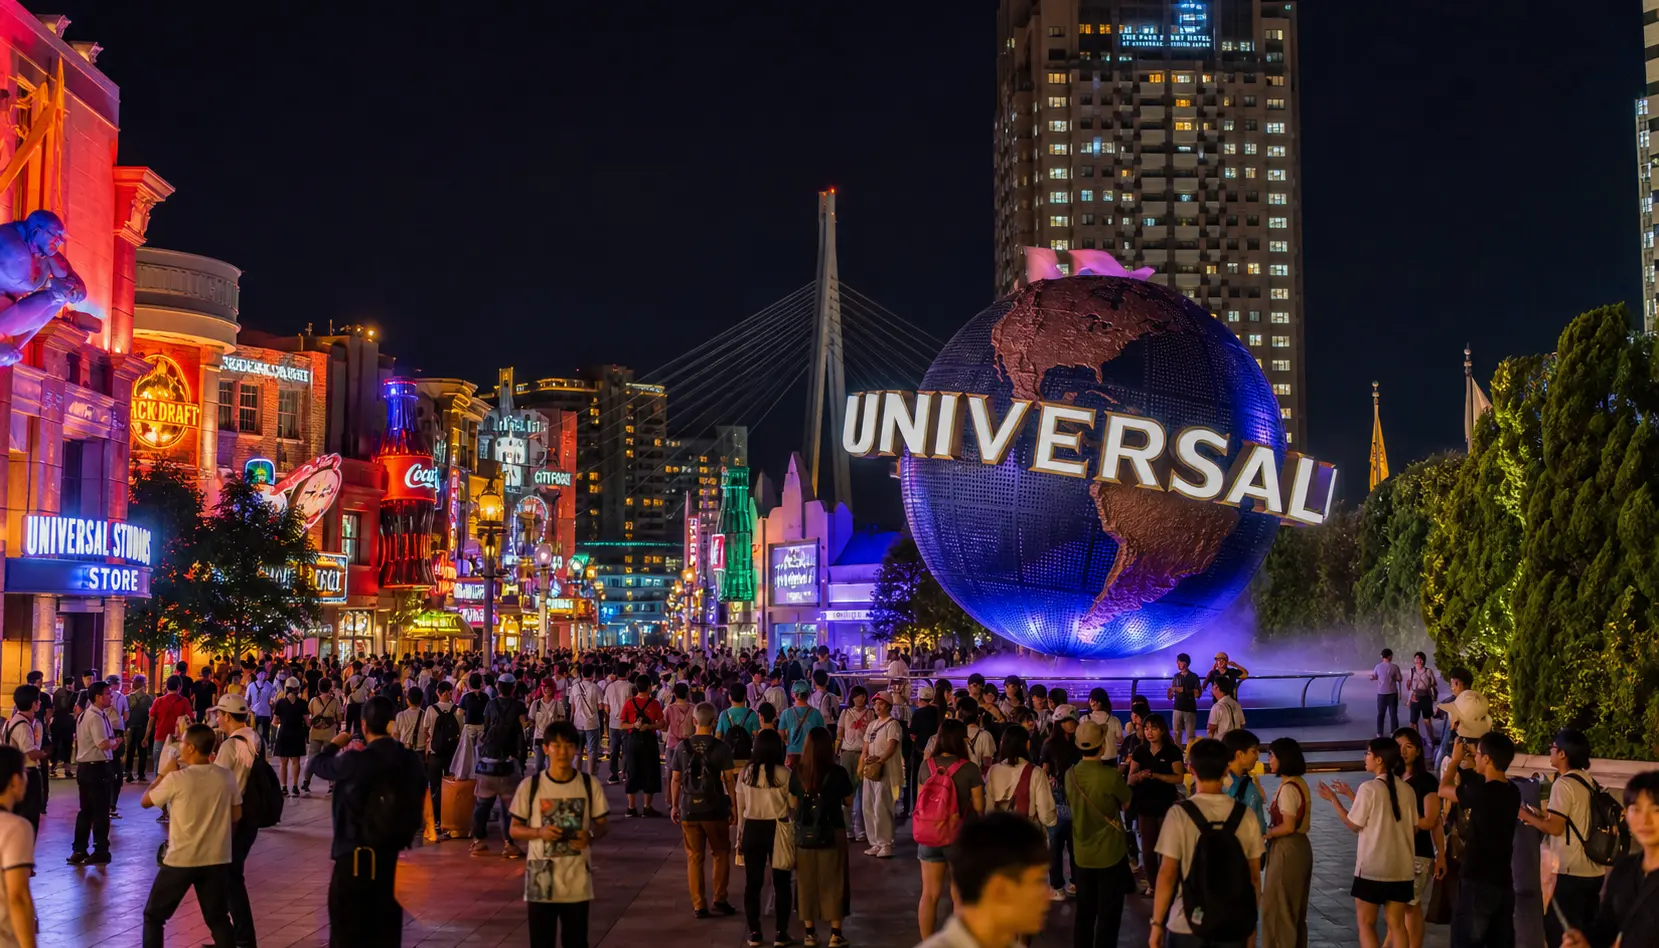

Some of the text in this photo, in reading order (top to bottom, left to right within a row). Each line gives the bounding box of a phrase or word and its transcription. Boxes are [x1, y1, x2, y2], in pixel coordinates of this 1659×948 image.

[158, 402, 199, 425] DRAFT
[842, 390, 1337, 524] UNIVERSAL
[27, 516, 151, 566] UNIVERSAL STUDIOS
[89, 567, 138, 591] STORE
